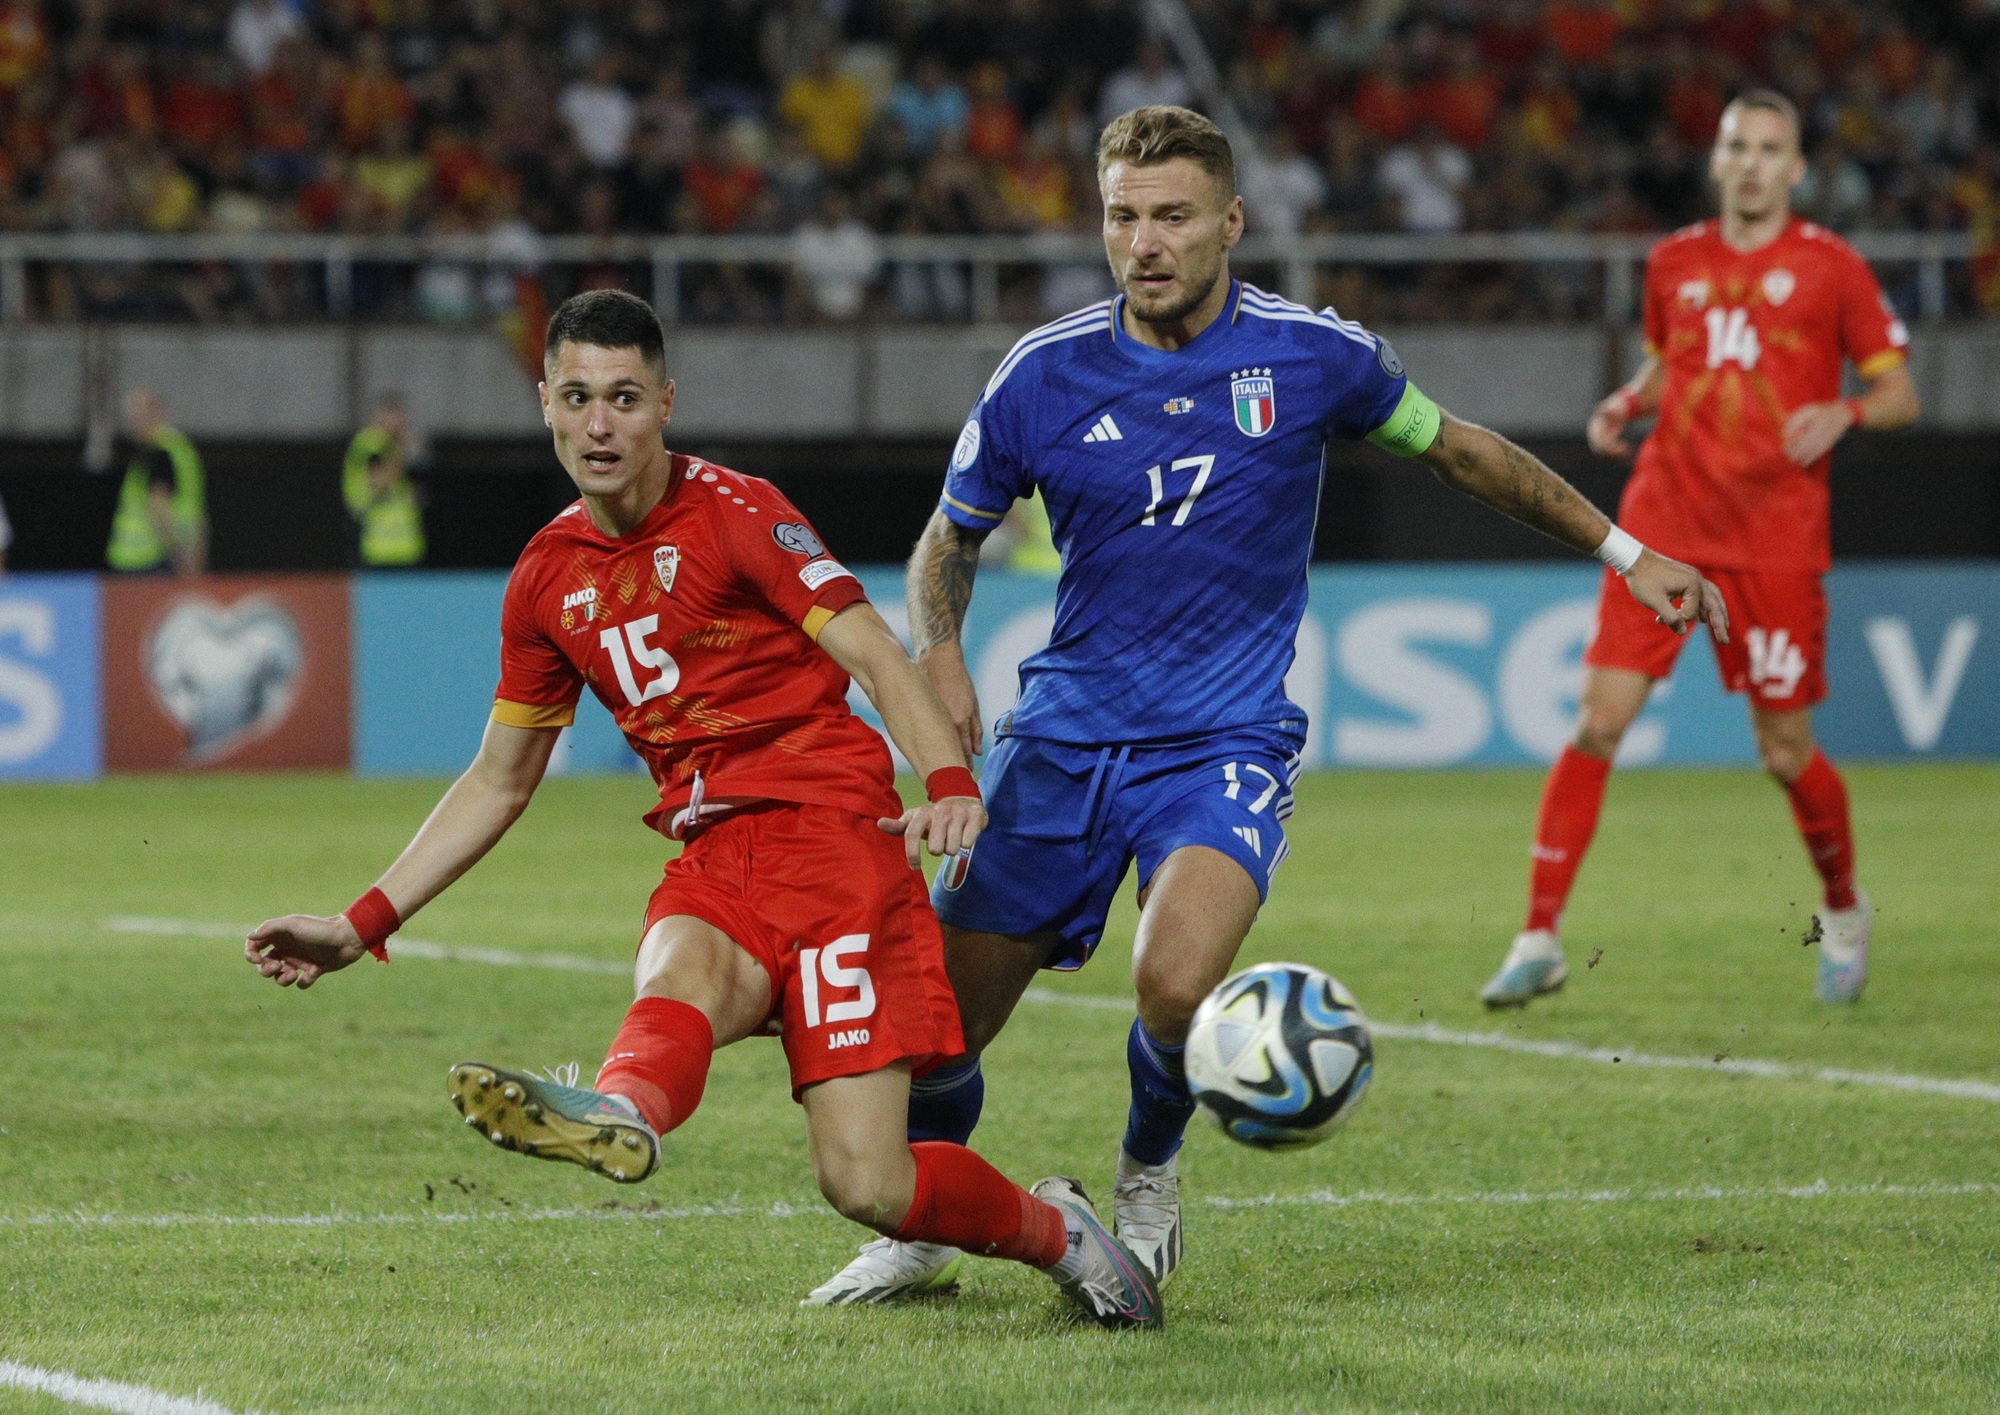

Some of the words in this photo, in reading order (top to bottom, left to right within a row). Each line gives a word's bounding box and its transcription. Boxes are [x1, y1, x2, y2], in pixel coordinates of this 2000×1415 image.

[1705, 307, 1761, 371] 14
[1235, 382, 1270, 395] ITALIA
[1141, 454, 1216, 526] 17
[563, 587, 596, 610] JAKO
[600, 613, 680, 707] 15
[1744, 626, 1807, 696] 14
[1864, 617, 1978, 749] V
[1222, 761, 1280, 815] 17
[800, 934, 876, 1029] 15
[828, 1029, 870, 1050] JAKO
